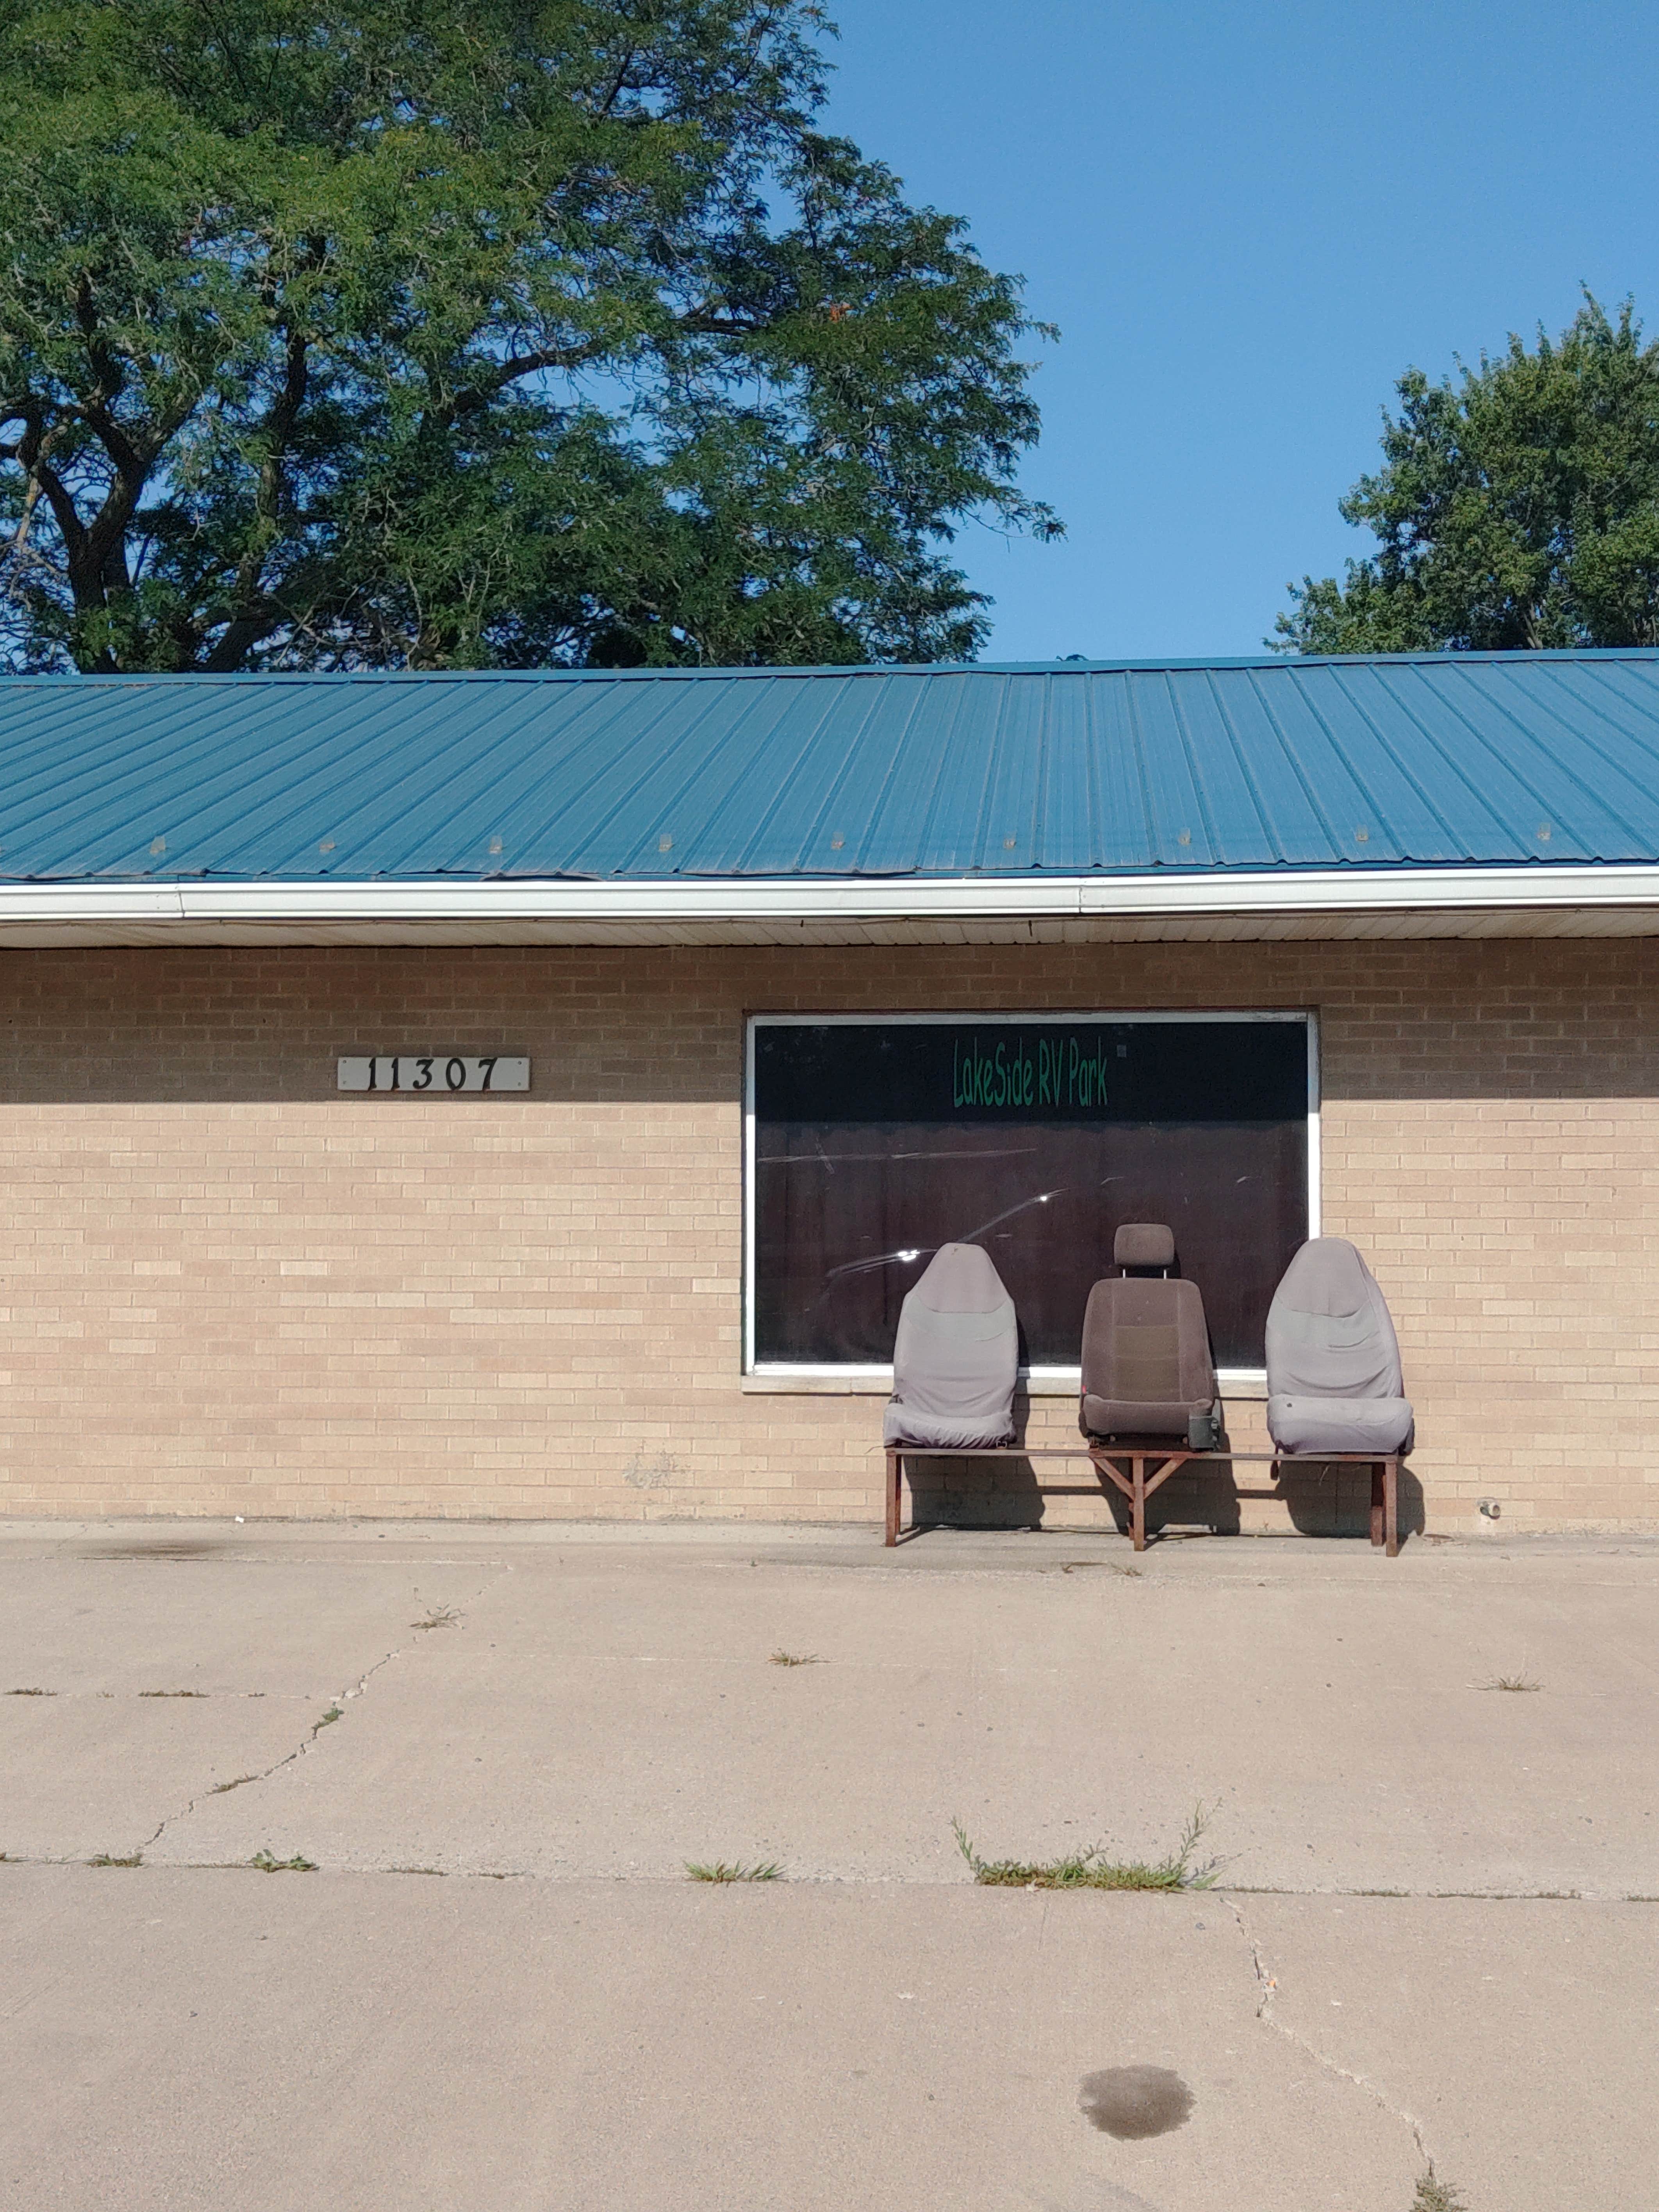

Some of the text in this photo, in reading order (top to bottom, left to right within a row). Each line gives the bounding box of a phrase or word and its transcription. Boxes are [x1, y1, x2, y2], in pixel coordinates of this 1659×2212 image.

[367, 1057, 498, 1091] 11307
[954, 1036, 1107, 1107] LakeSide RV Park
